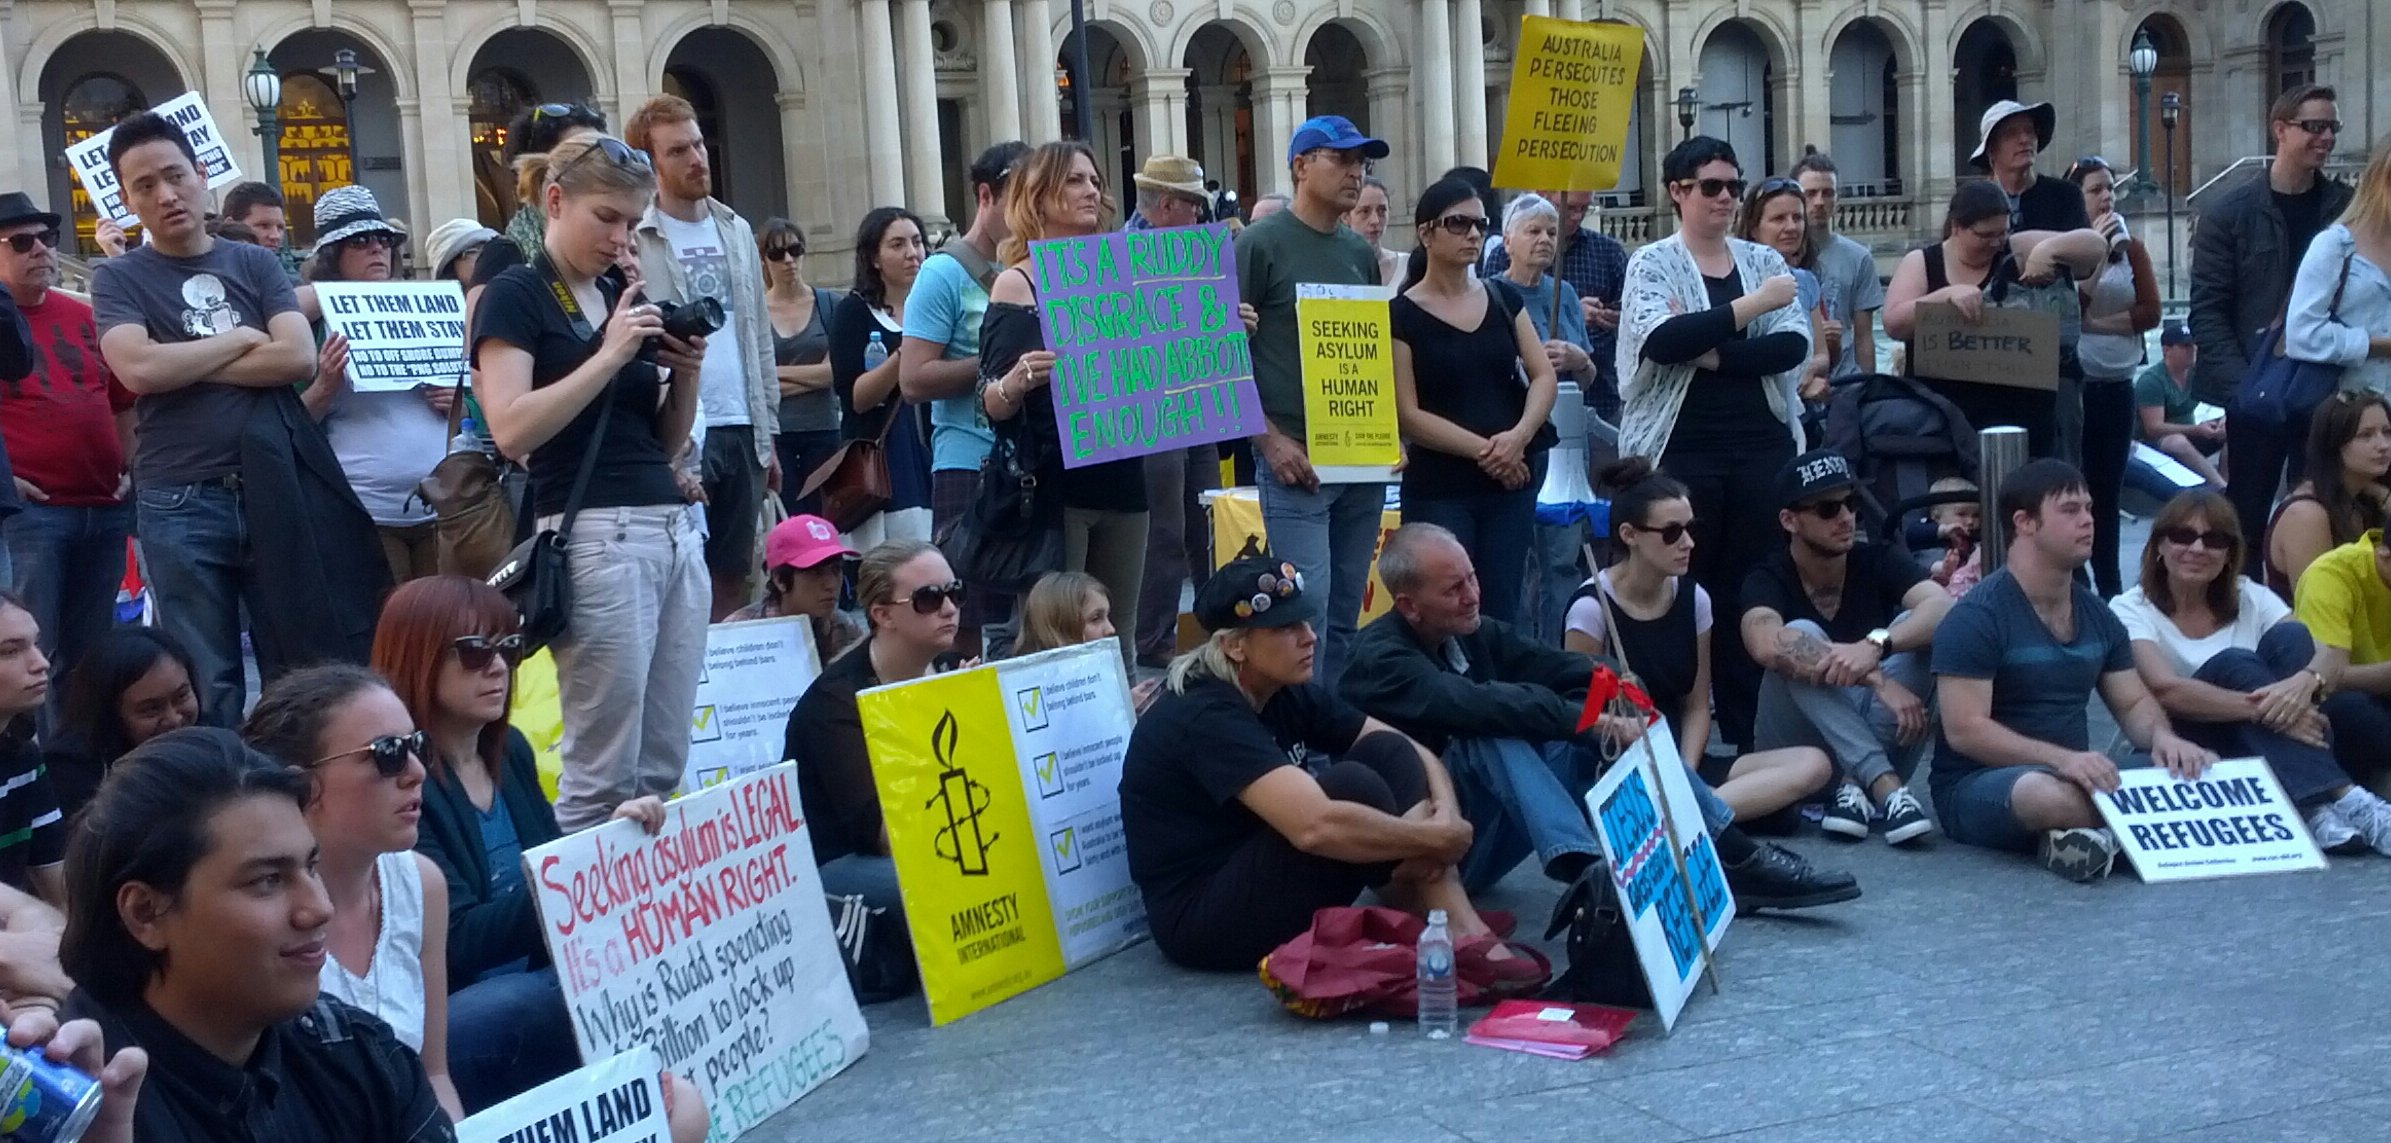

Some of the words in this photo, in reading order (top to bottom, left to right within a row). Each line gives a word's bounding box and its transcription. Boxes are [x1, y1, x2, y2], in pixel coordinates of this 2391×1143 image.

[1541, 34, 1622, 62] AUSTRALIA
[1529, 58, 1626, 86] PERSECUTES
[1550, 88, 1599, 109] THOSE
[79, 144, 108, 170] LET
[165, 104, 202, 127] AND
[186, 124, 212, 147] AY
[1533, 112, 1597, 134] FLEEING
[1516, 139, 1617, 162] PERSECUTION
[1035, 238, 1089, 293] IT'S
[1096, 237, 1119, 287] A
[1126, 226, 1229, 278] RUDDY
[330, 295, 360, 314] LET
[362, 295, 414, 314] THEM
[413, 294, 460, 314] LAND
[1046, 284, 1188, 347] DISGRACE
[1200, 284, 1228, 333] &
[342, 321, 372, 340] LET
[374, 320, 426, 340] THEM
[426, 320, 464, 338] STAY
[1312, 320, 1379, 339] SEEKING
[1923, 334, 1938, 352] IS
[1948, 330, 2032, 354] BETTER
[352, 350, 368, 362] NO
[368, 350, 383, 362] TO
[1316, 342, 1378, 360] ASYLUM
[358, 364, 374, 376] NO
[374, 364, 389, 376] TO
[1054, 351, 1108, 407] I'VE
[1108, 346, 1162, 397] HAD
[1166, 331, 1252, 387] ABBOTT
[1339, 364, 1349, 375] IS
[1352, 364, 1358, 375] A
[1322, 378, 1378, 396] HUMAN
[1329, 400, 1374, 417] RIGHT
[1070, 390, 1206, 460] ENOUGH
[2108, 777, 2274, 816] WELCOME
[2128, 813, 2294, 850] REFUGEES
[541, 834, 653, 936] Seeking
[652, 805, 722, 888] asylum
[718, 808, 739, 853] is
[604, 938, 624, 977] a
[621, 874, 722, 965] HUMAN
[951, 891, 1019, 942] AMNESTY
[957, 924, 1026, 965] INTERNATIONAL
[576, 989, 644, 1052] Why
[636, 977, 658, 1018] is
[656, 940, 714, 1006] Rudd
[715, 909, 792, 982] spending
[710, 997, 733, 1034] to
[730, 966, 774, 1020] lock
[773, 956, 795, 995] up
[705, 1008, 774, 1098] people?
[724, 1018, 846, 1131] REFUGEES
[580, 1078, 652, 1140] LAND
